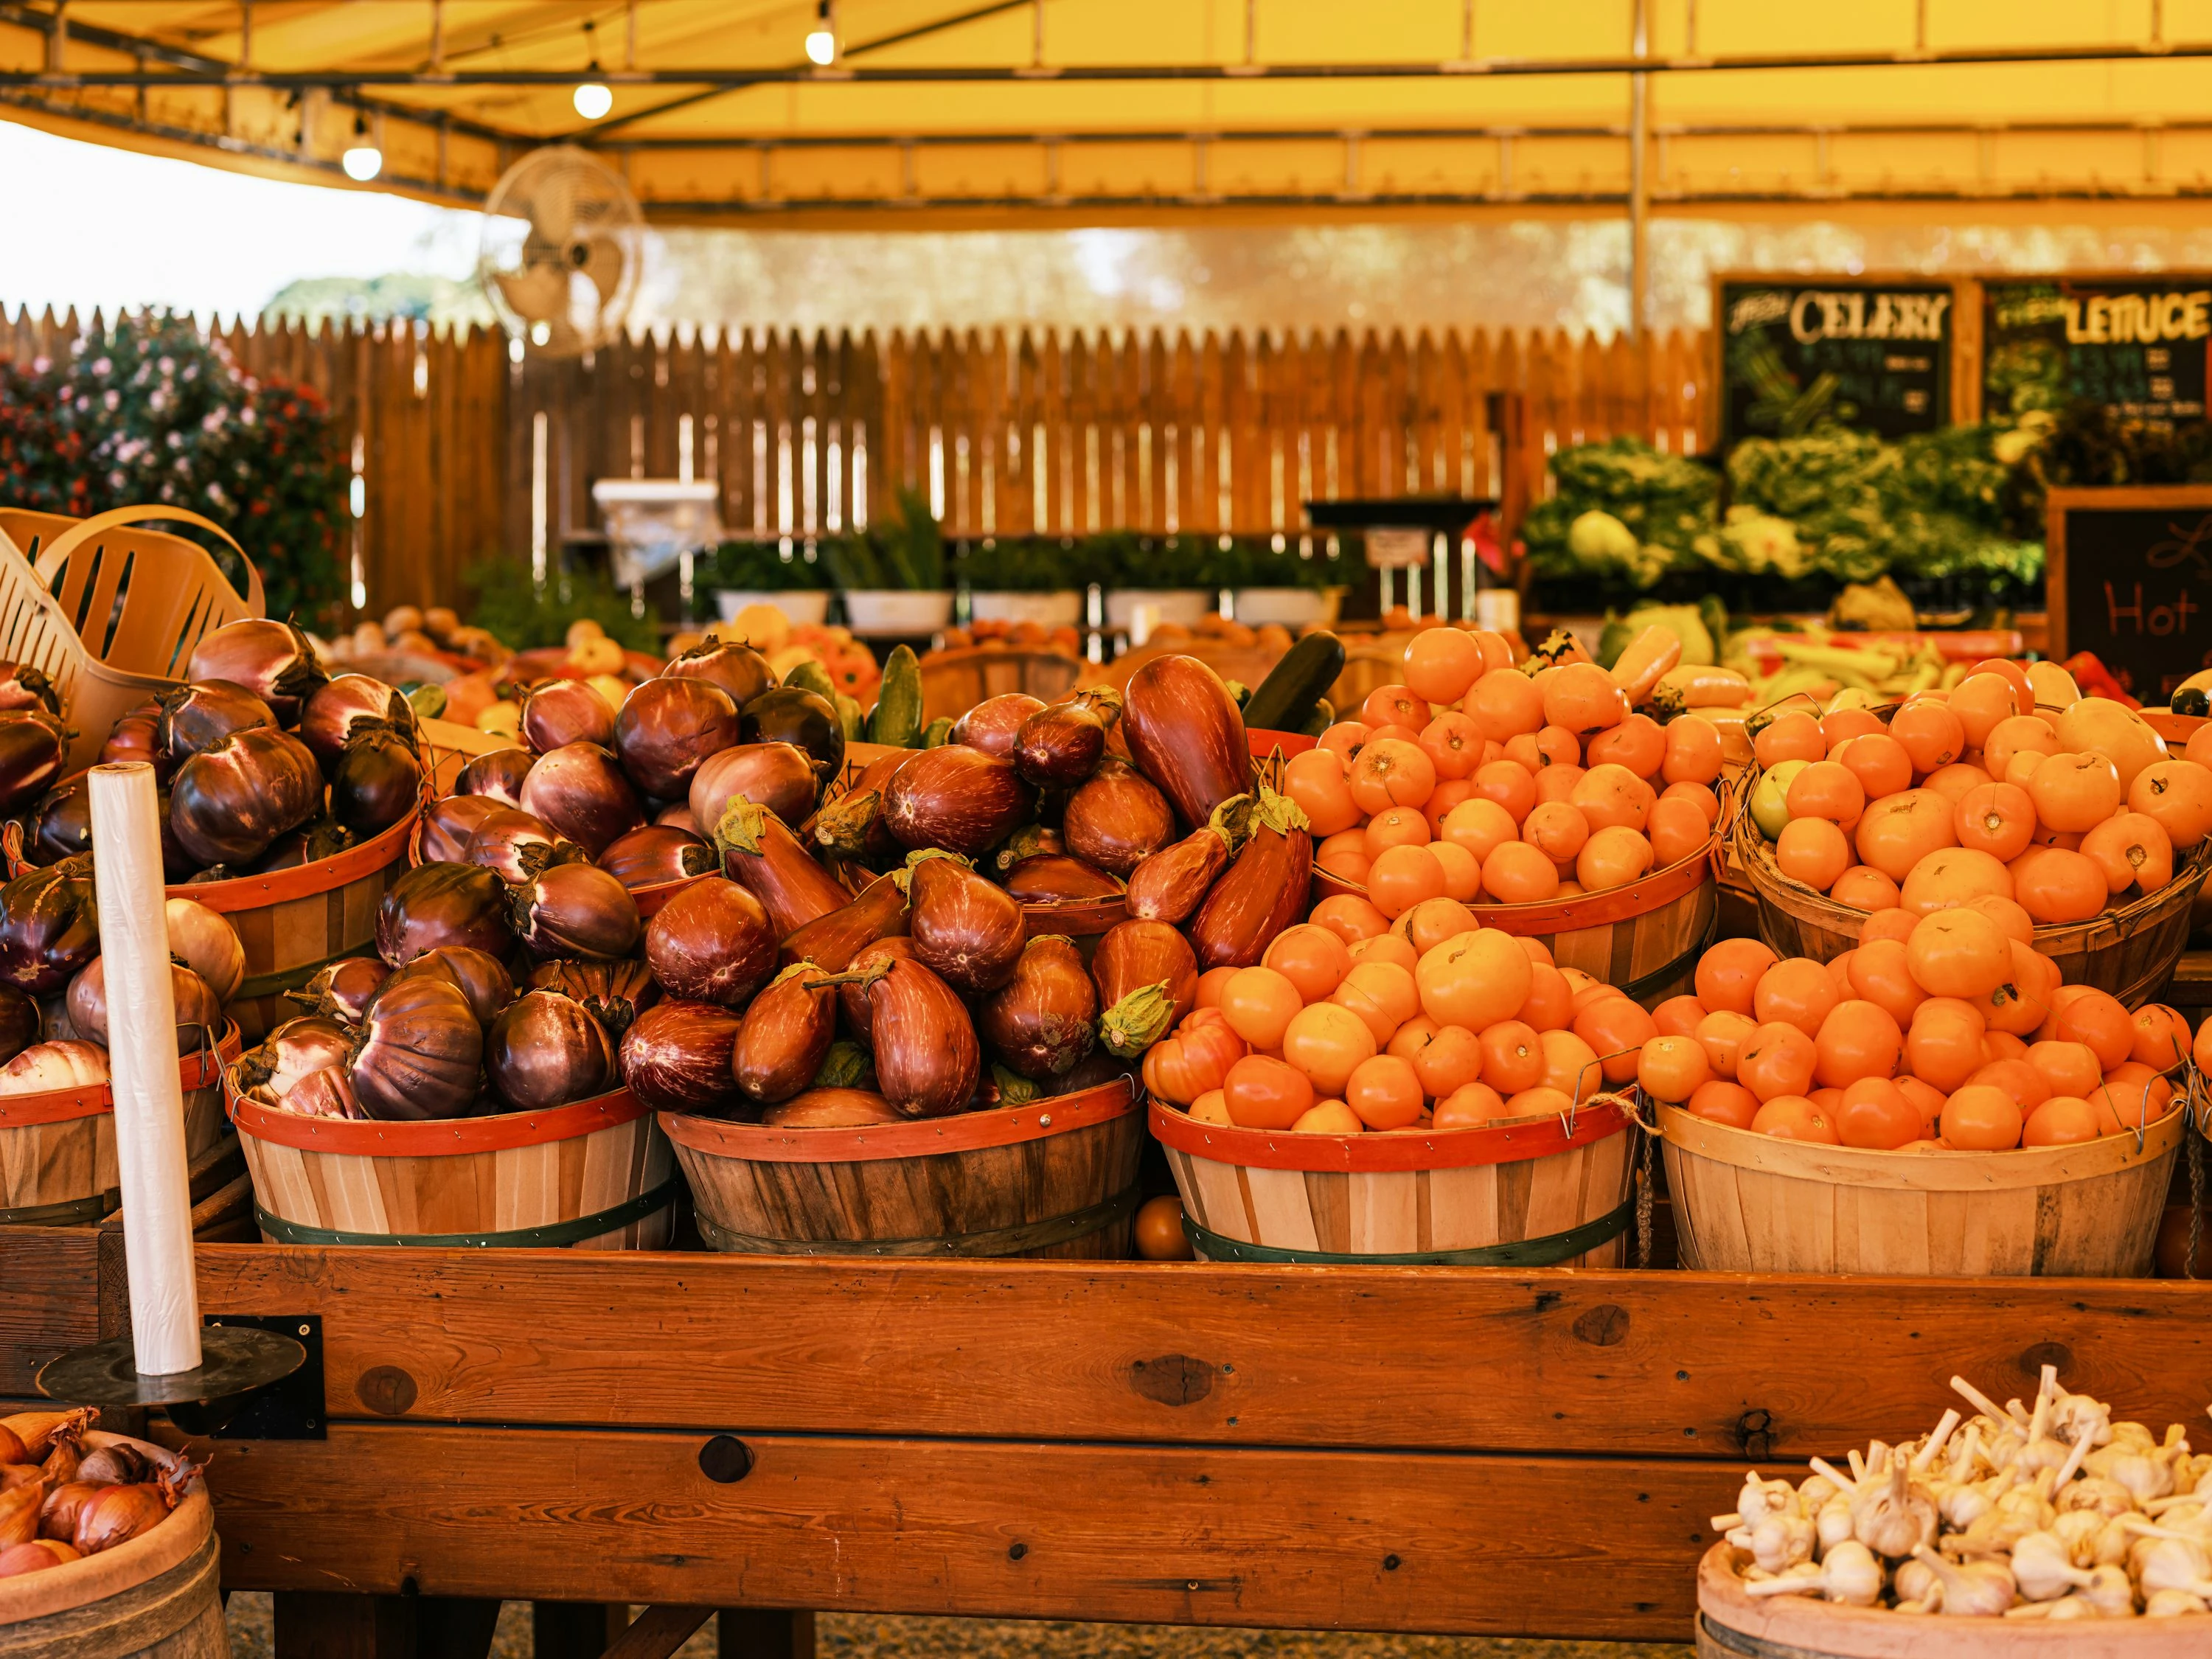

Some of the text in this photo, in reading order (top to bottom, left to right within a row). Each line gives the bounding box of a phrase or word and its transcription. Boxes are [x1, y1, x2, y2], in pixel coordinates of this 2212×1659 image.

[1791, 291, 1949, 344] CELERY
[2067, 292, 2211, 344] LETTUCE
[2104, 580, 2199, 636] Hot
